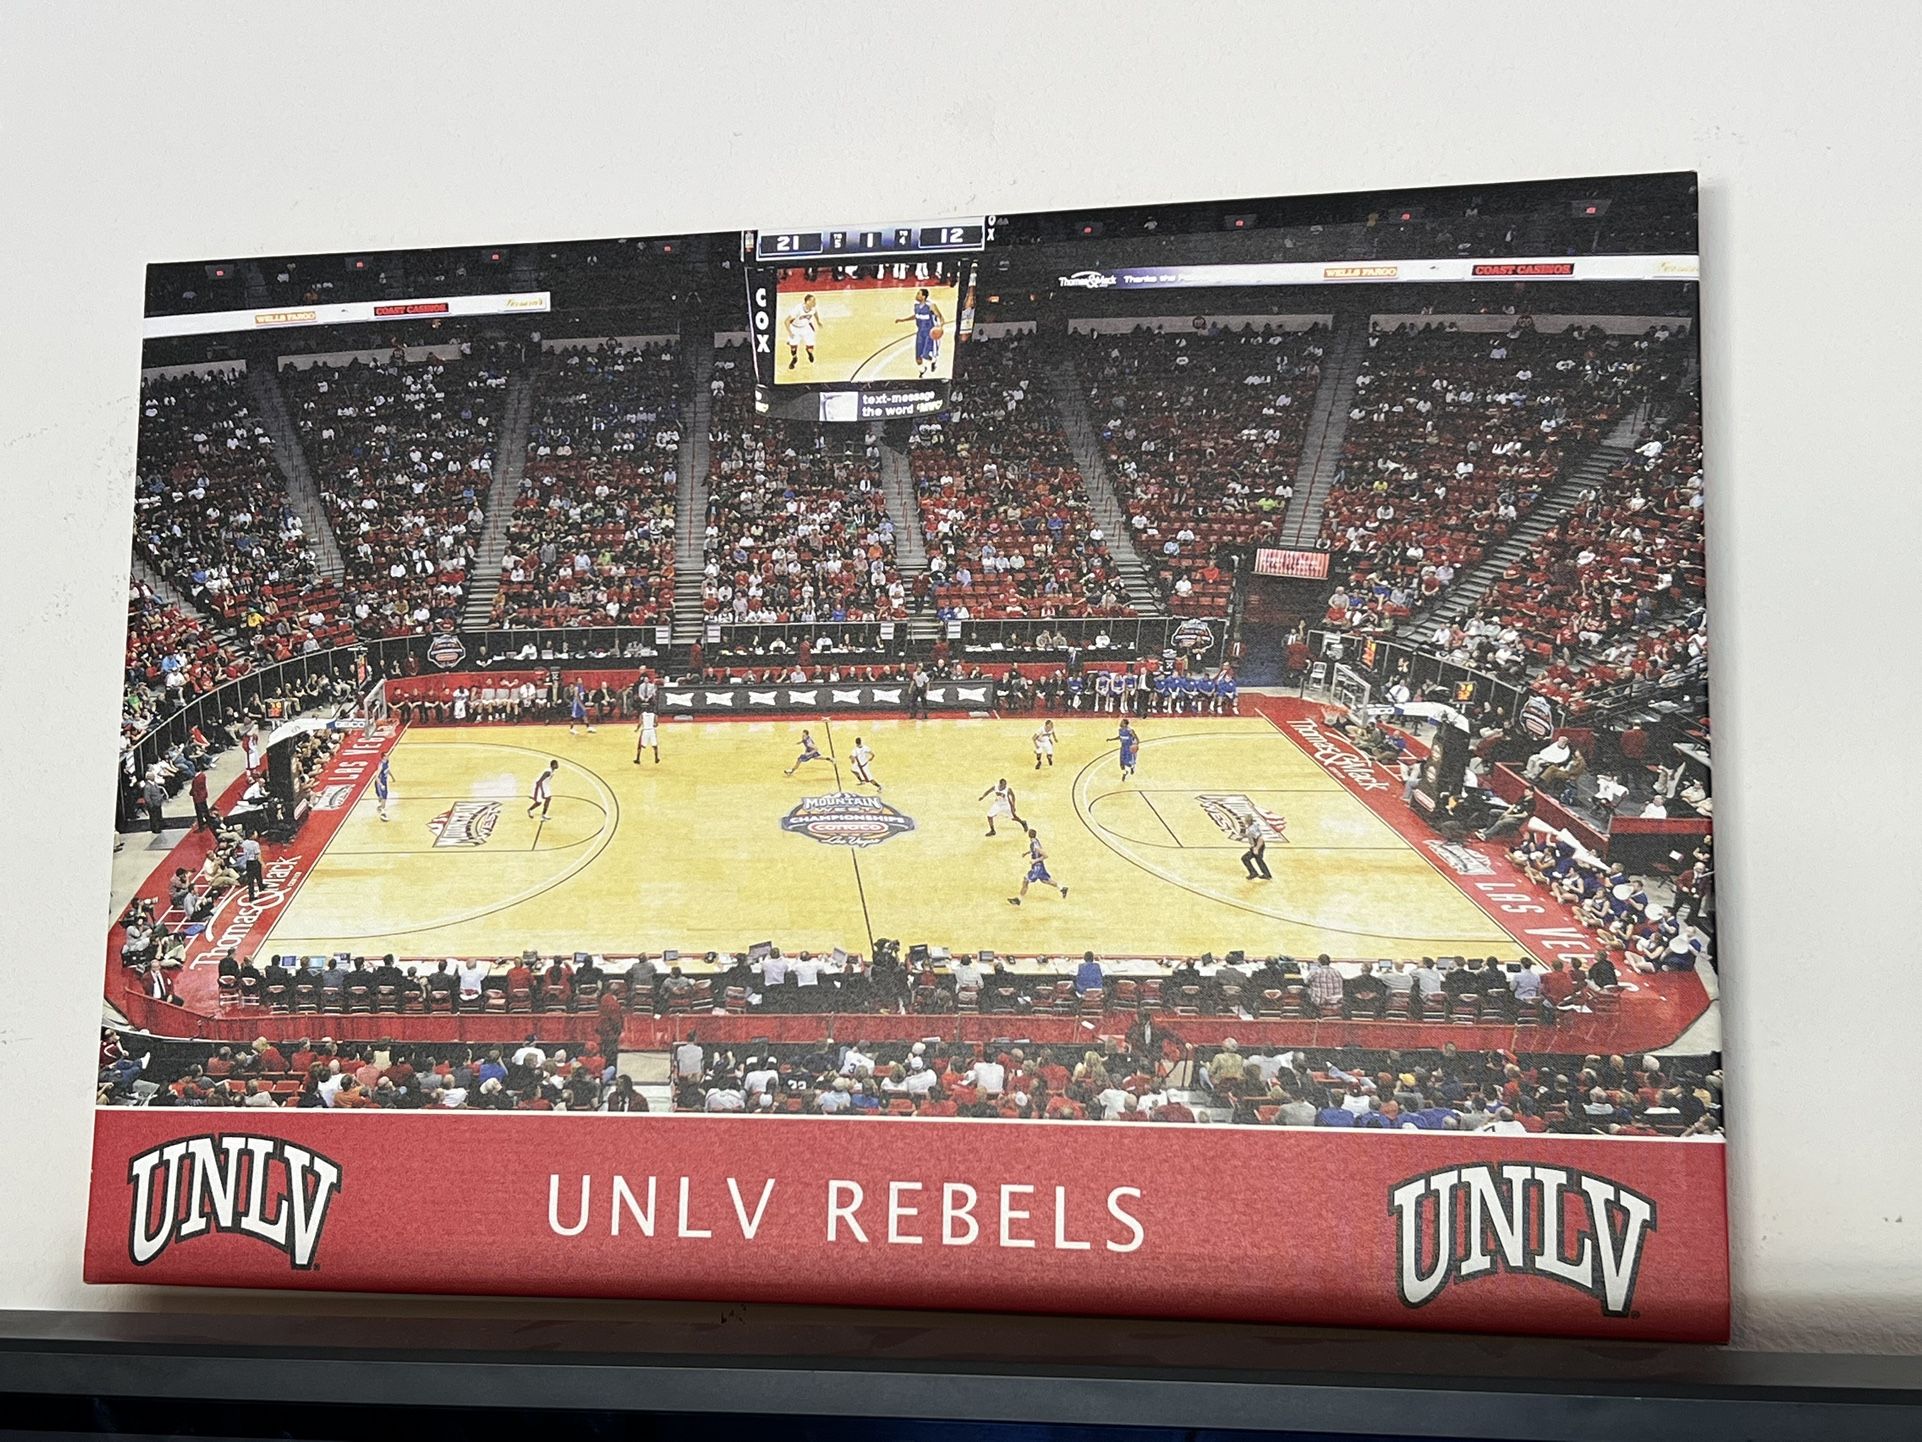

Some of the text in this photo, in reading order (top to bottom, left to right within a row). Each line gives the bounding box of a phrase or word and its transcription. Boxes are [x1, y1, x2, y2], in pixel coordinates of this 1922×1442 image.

[940, 227, 964, 243] 12
[776, 235, 799, 251] 21
[1325, 267, 1397, 278] WELLS FARGO
[1475, 263, 1572, 276] COAST CASINOS
[375, 305, 406, 316] COAST
[256, 314, 287, 324] WELLS
[862, 406, 883, 417] the
[885, 404, 914, 417] word
[803, 796, 883, 810] MOUNTAIN
[789, 814, 906, 824] CHAMPIONSHIPS
[1474, 881, 1546, 914] LAS
[128, 1133, 342, 1269] UNLV
[547, 1173, 1146, 1254] UNLV REBELS
[1388, 1161, 1657, 1318] UNLV
